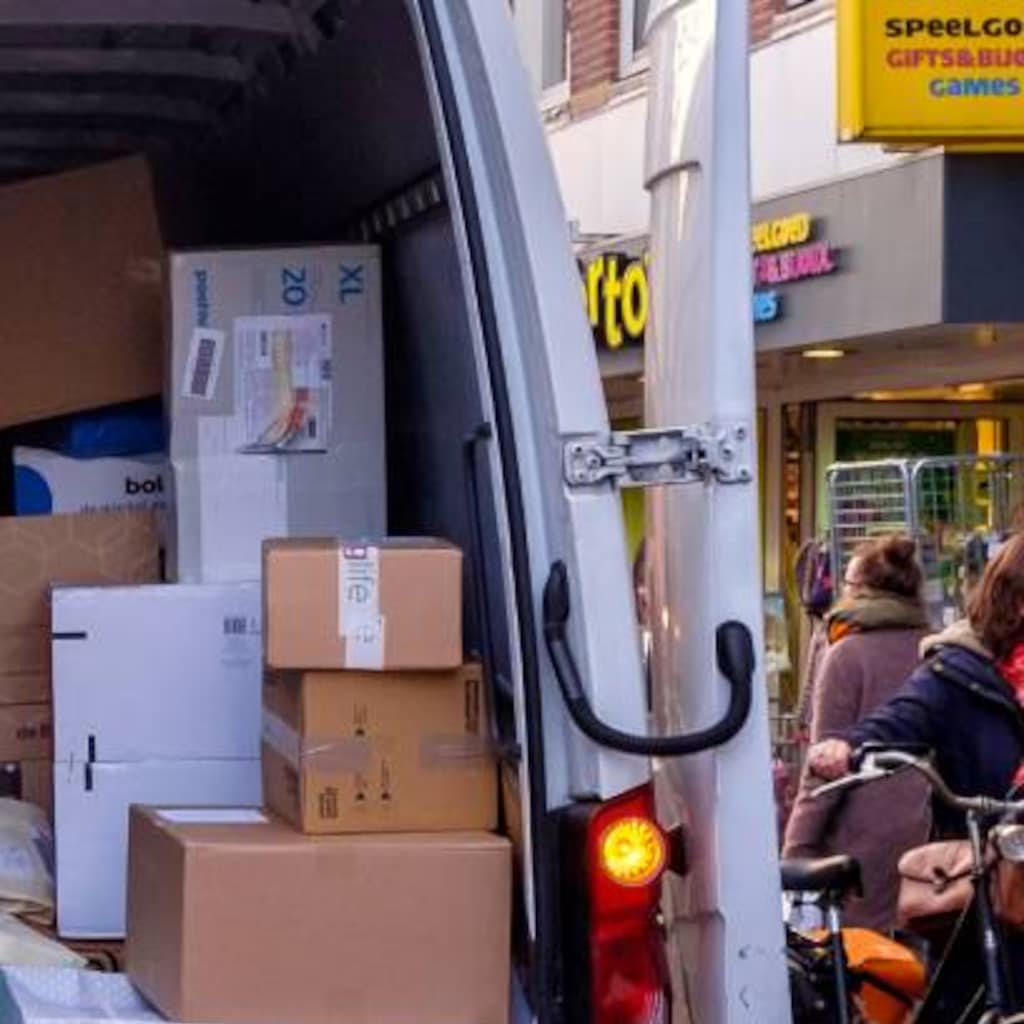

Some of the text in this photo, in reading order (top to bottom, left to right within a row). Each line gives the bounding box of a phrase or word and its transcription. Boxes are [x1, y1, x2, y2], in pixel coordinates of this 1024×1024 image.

[339, 263, 364, 304] XL
[582, 252, 650, 347] rto
[124, 475, 164, 495] bol
